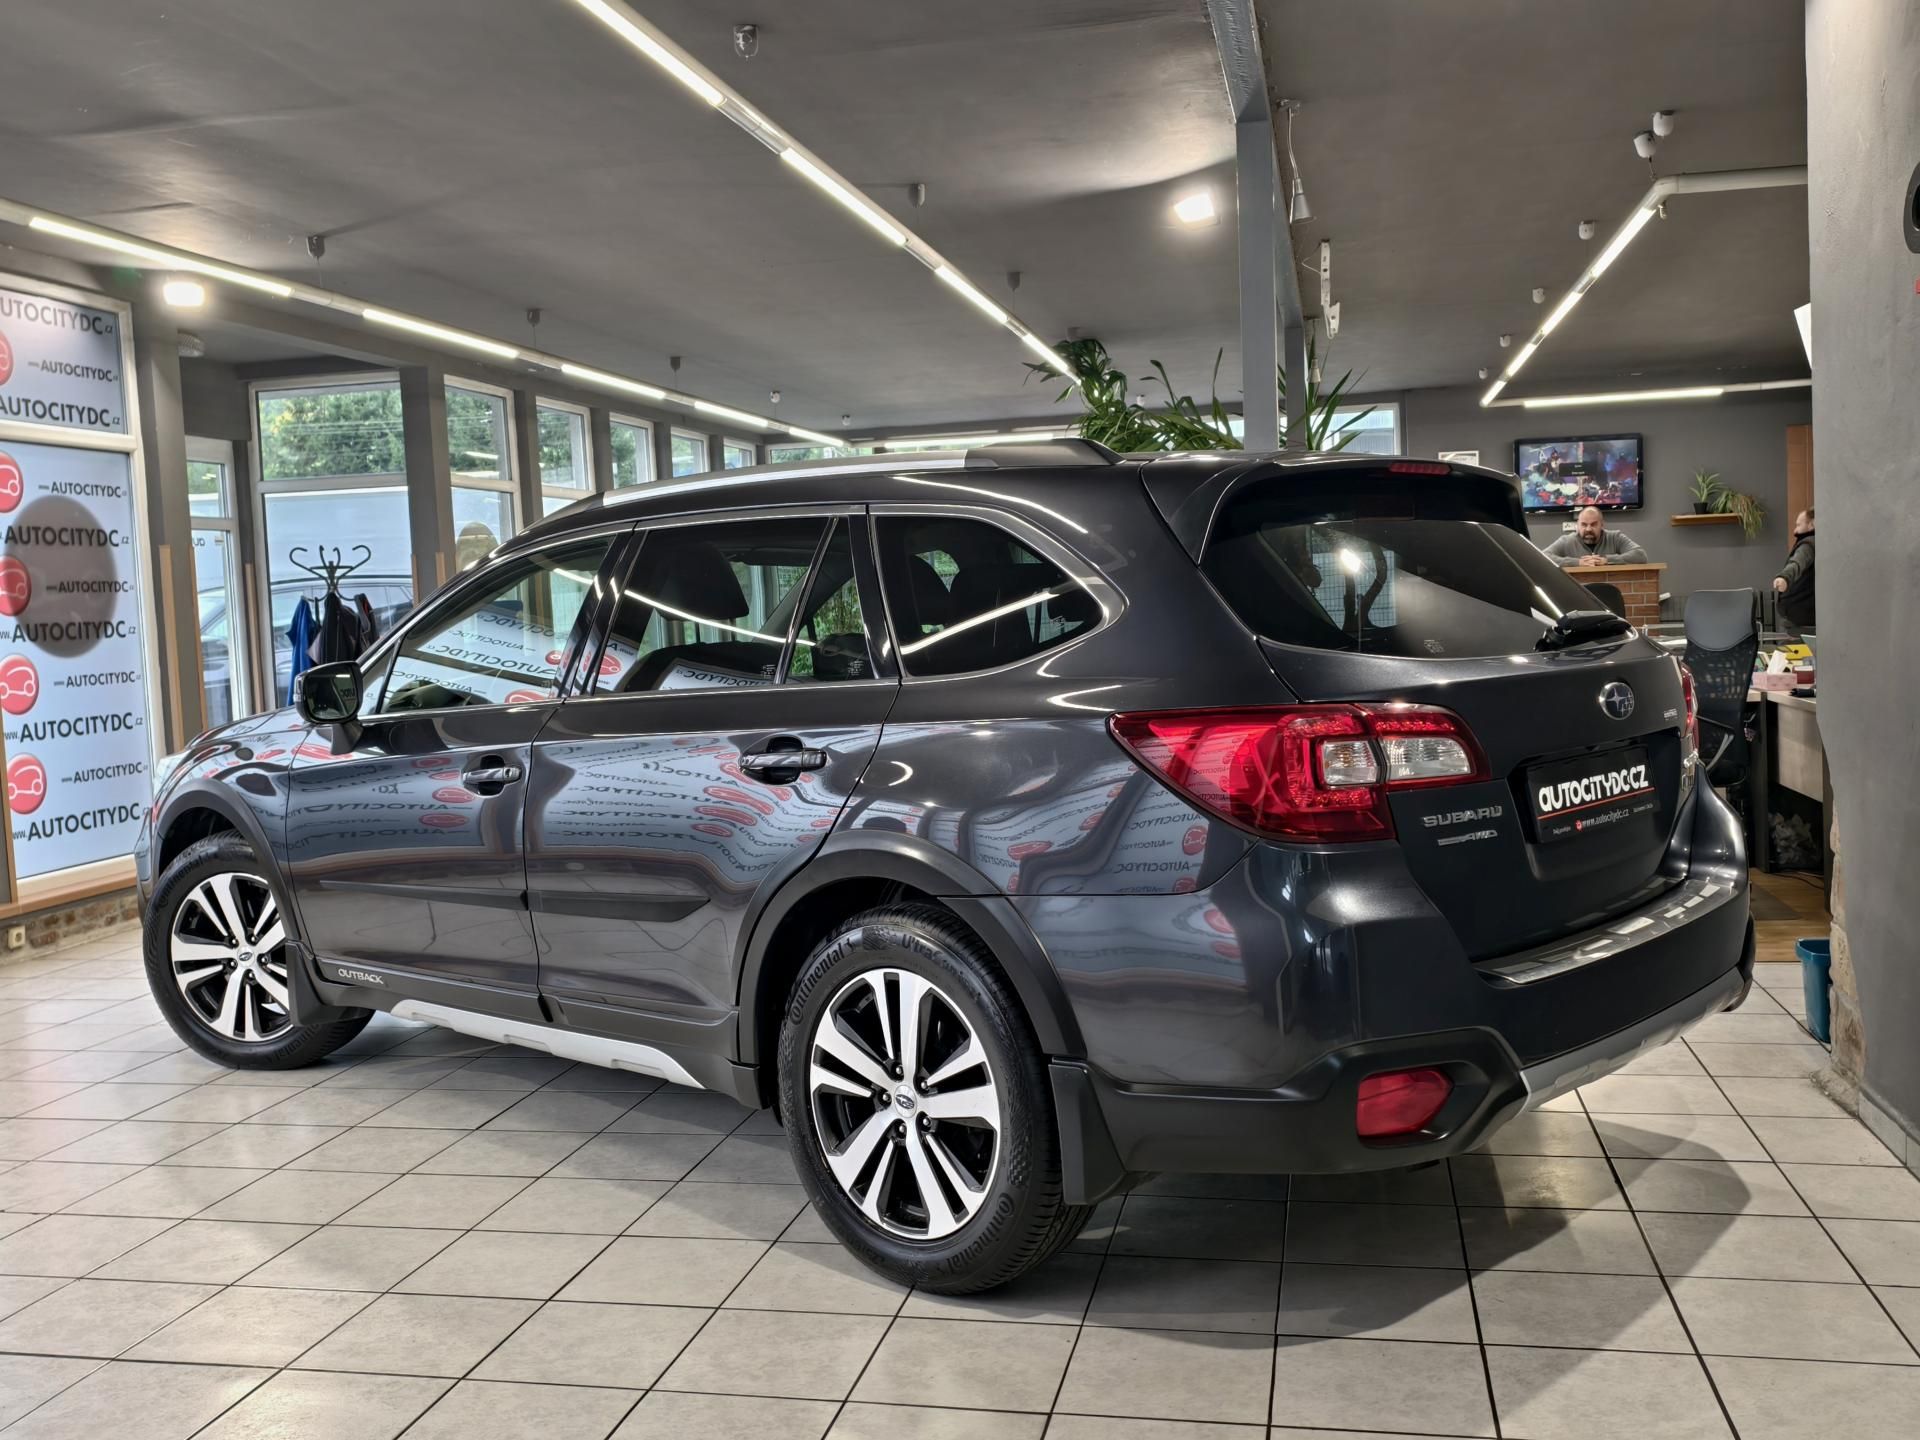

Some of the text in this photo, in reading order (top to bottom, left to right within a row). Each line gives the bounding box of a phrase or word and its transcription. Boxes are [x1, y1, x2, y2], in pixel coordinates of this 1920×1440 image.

[1423, 805, 1503, 828] SUBARU
[338, 968, 384, 985] OUTBACK
[789, 941, 846, 1026] Continental
